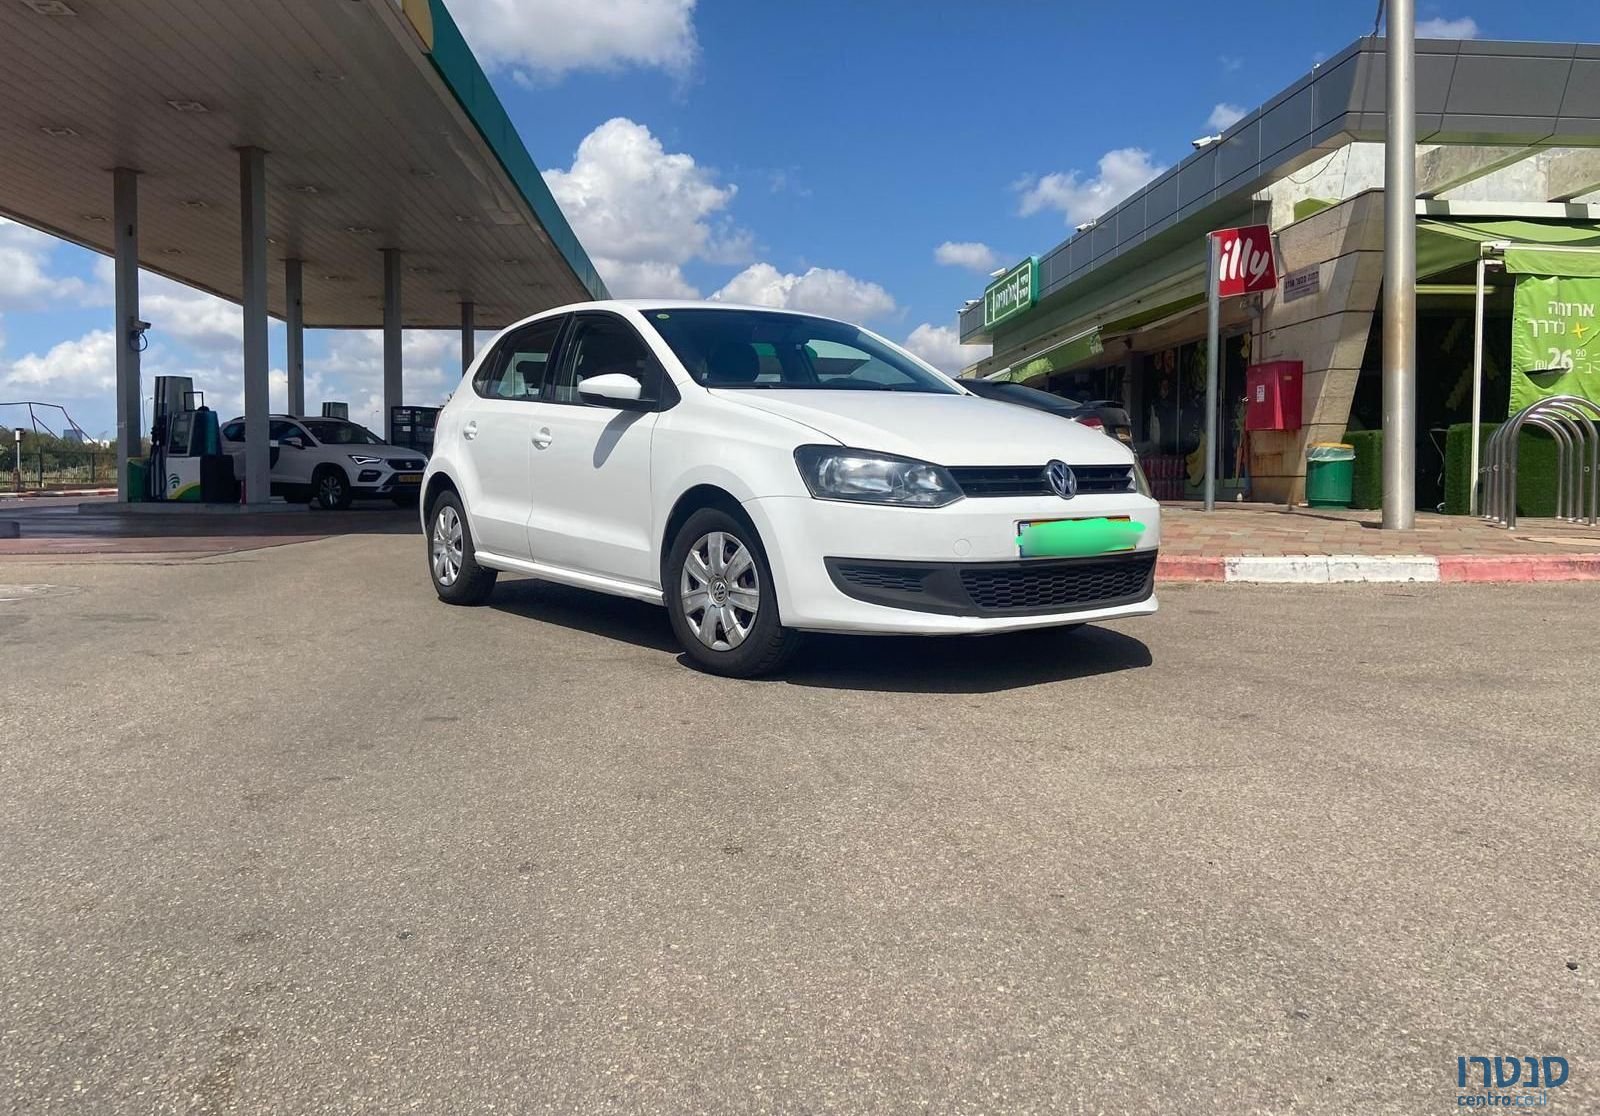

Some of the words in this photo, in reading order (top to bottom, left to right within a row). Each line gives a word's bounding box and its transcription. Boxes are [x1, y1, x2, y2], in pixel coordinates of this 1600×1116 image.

[1220, 237, 1269, 287] illy
[1548, 300, 1595, 317] ארוחה
[1527, 319, 1566, 337] לדרך
